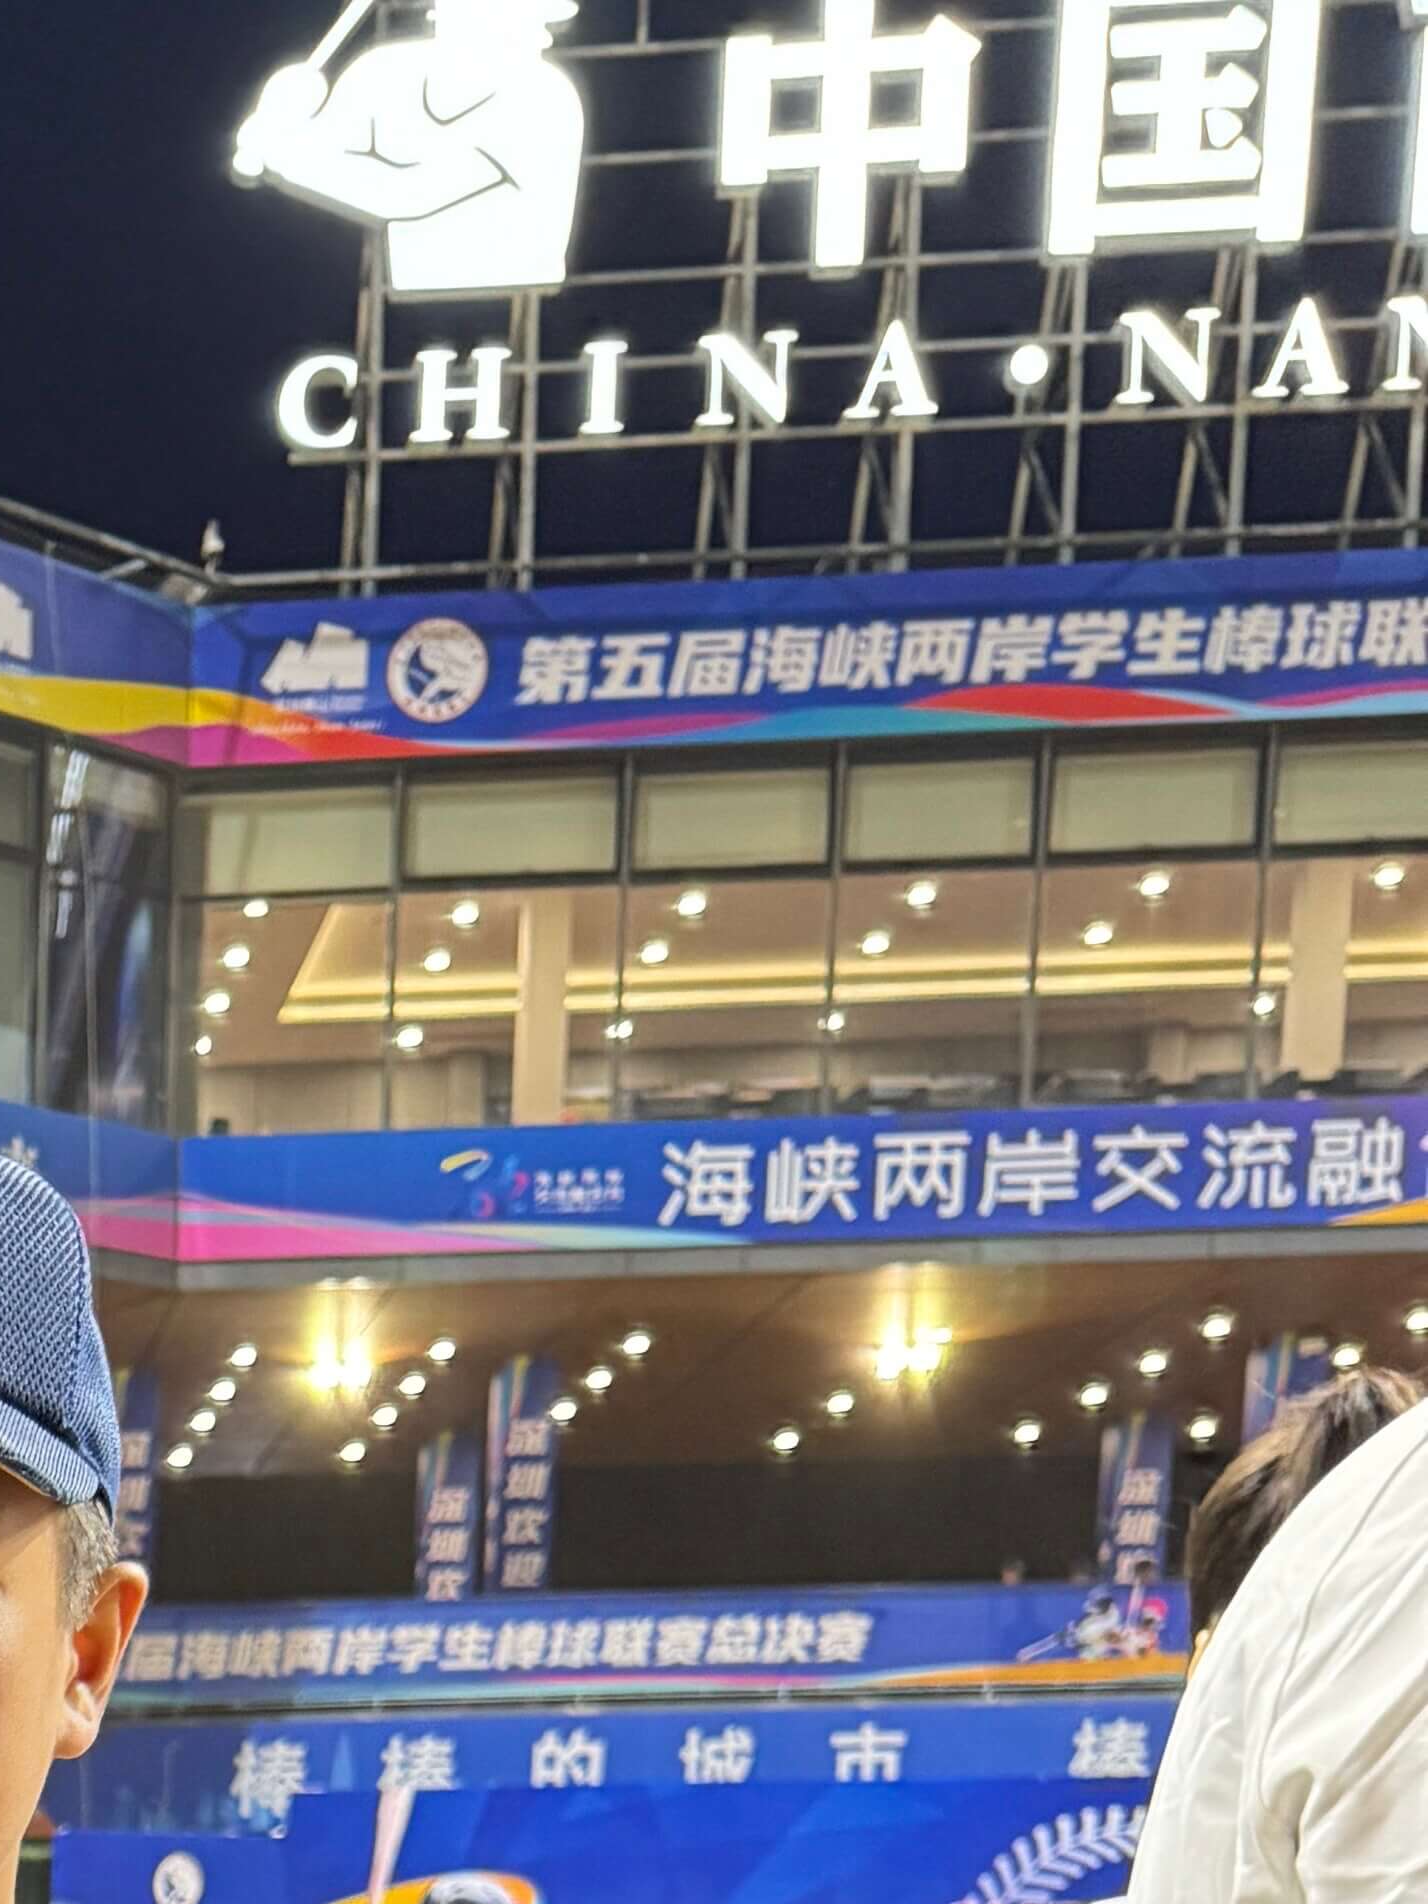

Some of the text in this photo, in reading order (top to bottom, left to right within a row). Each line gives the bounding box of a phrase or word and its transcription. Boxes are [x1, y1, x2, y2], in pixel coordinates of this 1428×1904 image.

[719, 0, 1428, 271] 中国
[515, 595, 1428, 705] 第五届海峡两岸学生棒球联
[657, 1115, 1428, 1229] 海峡两岸交流融
